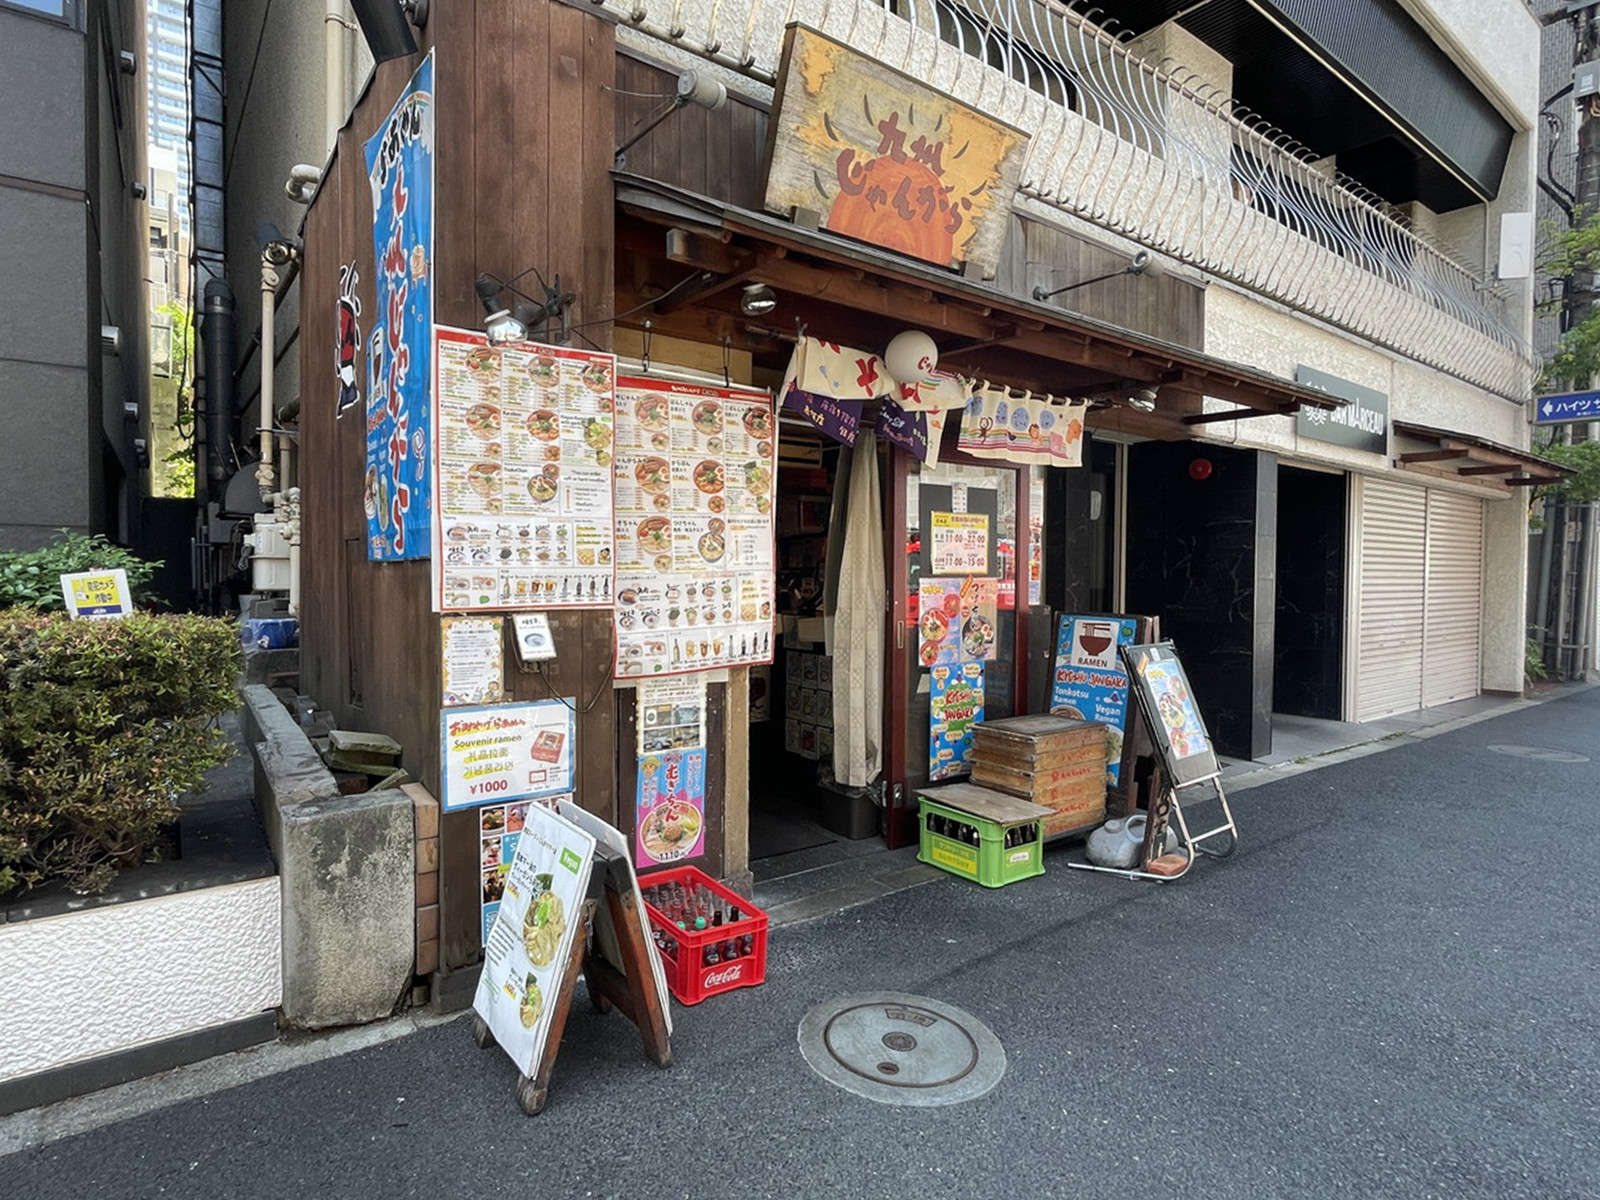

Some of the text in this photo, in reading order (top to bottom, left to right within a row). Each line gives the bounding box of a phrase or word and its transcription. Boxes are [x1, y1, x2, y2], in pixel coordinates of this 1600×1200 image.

[876, 111, 946, 178] 九州
[836, 148, 973, 235] じゃんがら
[1077, 657, 1108, 668] RAMEN
[1054, 686, 1090, 699] Tonkotsu
[1054, 695, 1077, 706] Ramen
[1095, 703, 1121, 717] Vegan
[1094, 713, 1120, 725] Ramen
[454, 734, 522, 749] Souvenir ramen
[469, 778, 508, 795] ¥1000
[563, 851, 579, 870] Vegan
